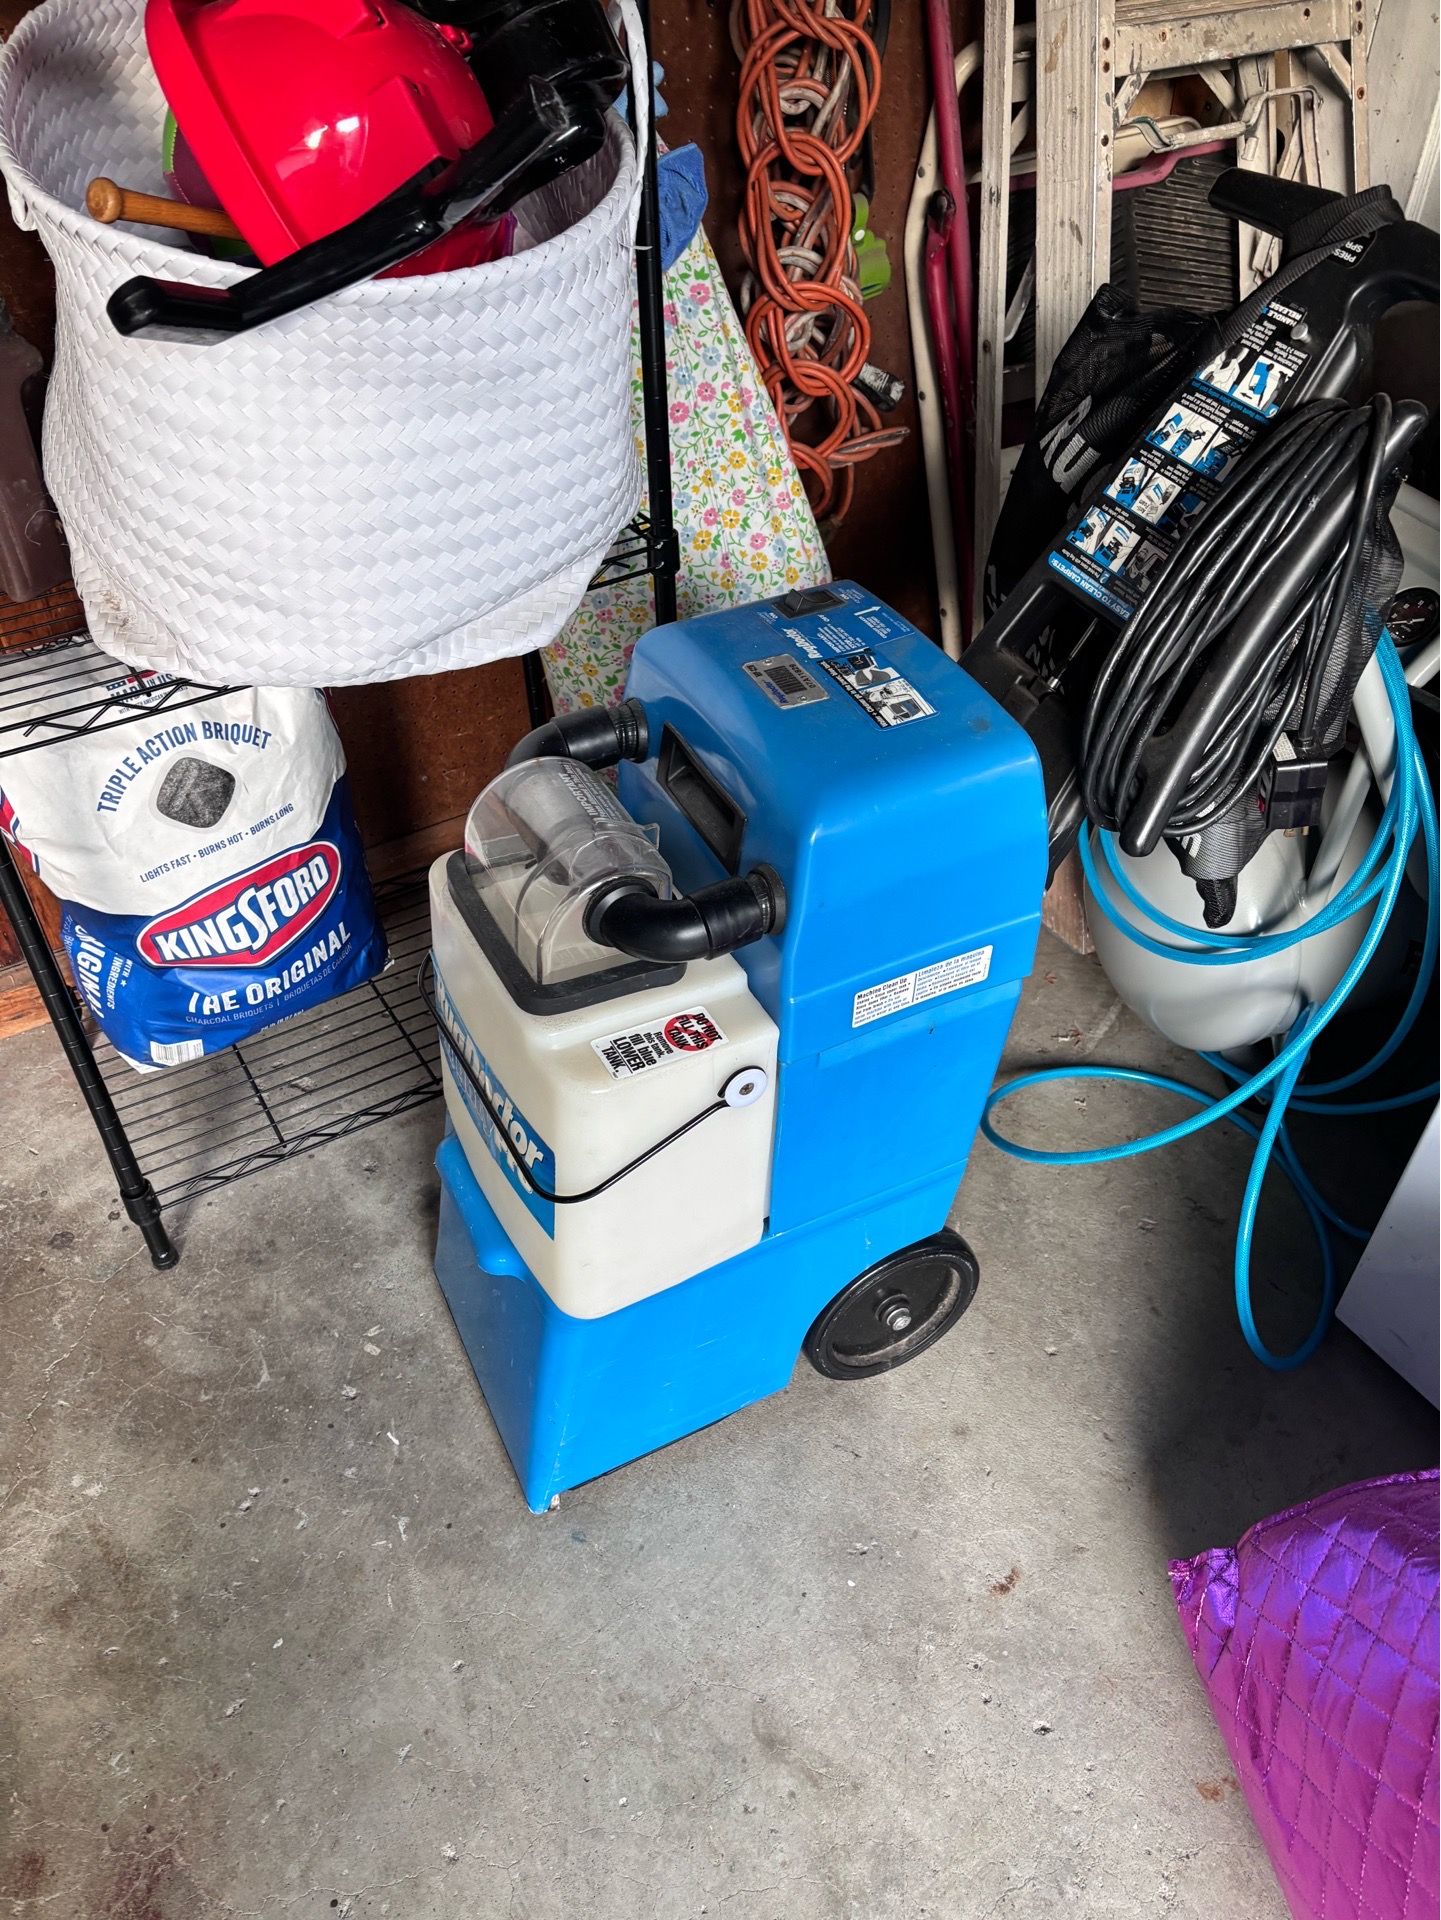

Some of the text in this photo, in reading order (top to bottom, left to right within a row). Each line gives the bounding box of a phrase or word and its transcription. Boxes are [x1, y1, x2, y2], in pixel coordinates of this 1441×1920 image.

[1267, 309, 1296, 327] HANDLE
[1268, 300, 1302, 320] RELEASE
[1138, 499, 1149, 508] Foam
[1050, 558, 1081, 582] CARPETS:
[1079, 578, 1103, 598] CLEAN
[1100, 594, 1112, 605] TO
[1111, 601, 1131, 618] EASY
[97, 720, 272, 812] TRIPLE ACTION BRIQUET
[558, 771, 598, 815] IMPORTANT
[140, 803, 295, 883] LIGHTS FAST BURNS HOT BURNS LONG
[153, 855, 329, 961] KINGSFORD
[122, 959, 133, 978] WITH
[246, 921, 351, 1005] ORIGINAL
[107, 956, 123, 1010] INGREDIENTS
[857, 986, 881, 1000] Machine
[882, 980, 898, 990] Clean
[185, 1014, 233, 1026] CHARCOAL
[233, 1001, 274, 1021] BRIQUETS
[284, 973, 323, 1001] BRIQUETAS
[323, 967, 333, 977] DE
[643, 1032, 653, 1044] this
[668, 1026, 690, 1049] TANK
[677, 1014, 709, 1049] FILL THIS
[693, 1012, 723, 1041] DO NOT
[613, 1036, 646, 1071] LOWER
[629, 1033, 657, 1065] fill blue
[653, 1031, 673, 1054] Remove
[602, 1047, 625, 1073] TANK.
